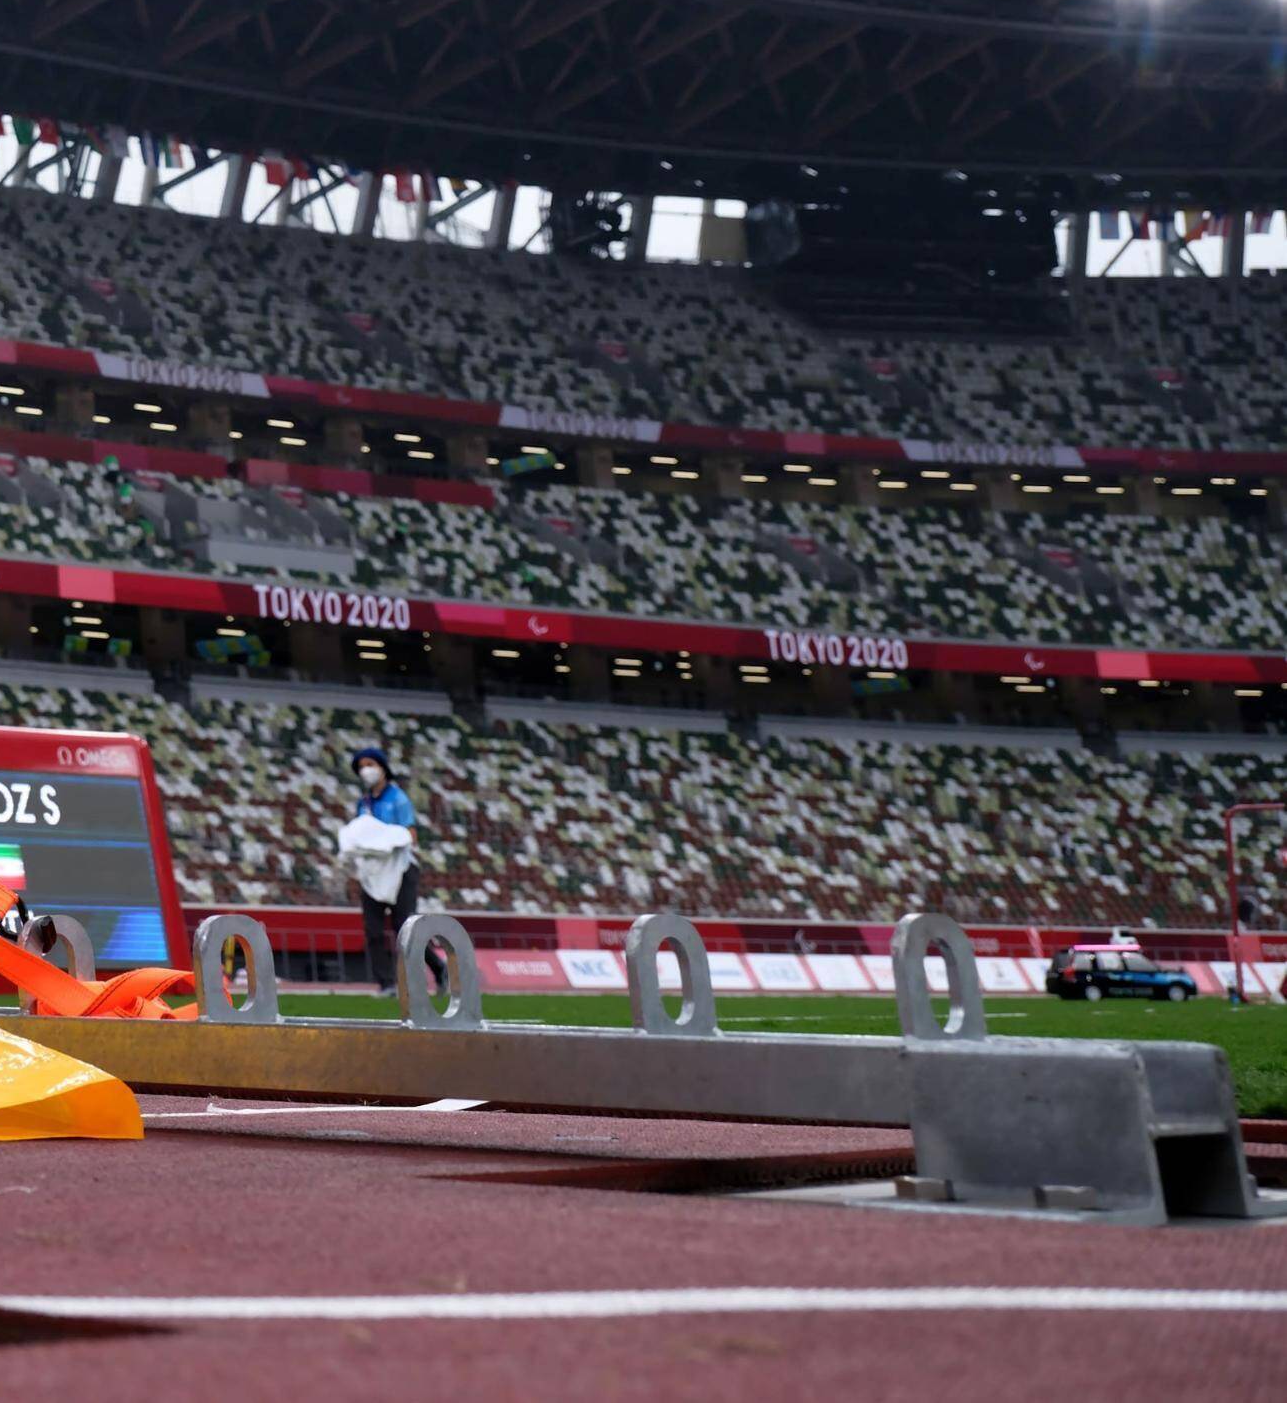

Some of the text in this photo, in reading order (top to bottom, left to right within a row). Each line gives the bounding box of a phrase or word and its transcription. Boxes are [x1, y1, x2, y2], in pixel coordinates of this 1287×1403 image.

[253, 584, 411, 631] TOKYO 2020
[763, 629, 909, 670] TOKYO 2020
[39, 784, 62, 826] S
